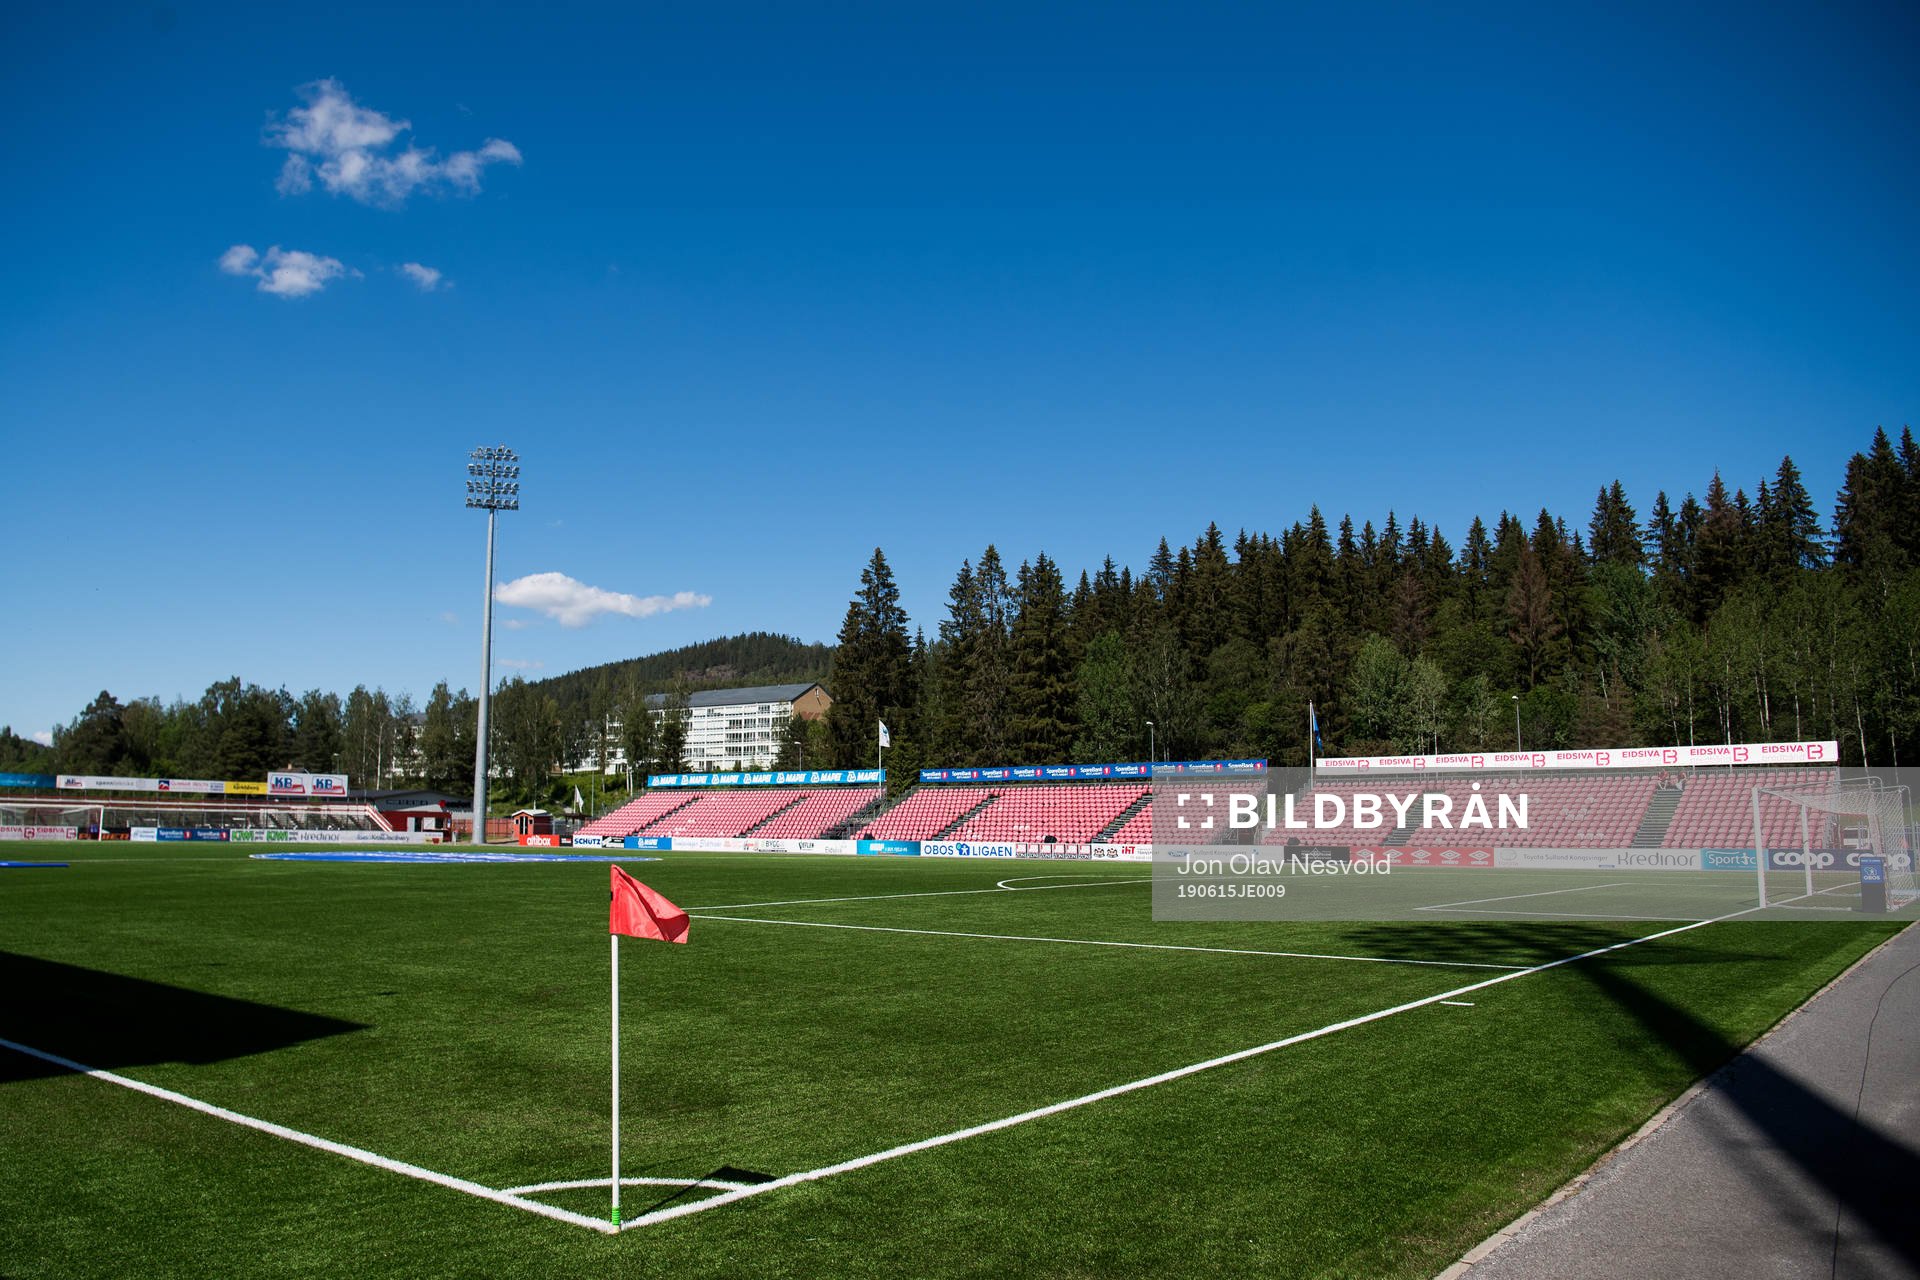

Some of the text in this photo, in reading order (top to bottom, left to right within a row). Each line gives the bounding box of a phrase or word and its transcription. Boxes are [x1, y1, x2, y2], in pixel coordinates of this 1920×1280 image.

[1690, 748, 1730, 756] EIDSIVA
[1761, 745, 1804, 753] EIDSIVA
[1435, 756, 1469, 764] EIDSIVA
[1495, 754, 1530, 762] EIDSIVA
[1557, 752, 1593, 760] EIDSIVA
[1379, 758, 1411, 766] EIDSIVA
[660, 776, 678, 784] MAPEI
[689, 775, 708, 784] MAPEI
[720, 775, 740, 783] MAPEI
[752, 774, 773, 783] MAPEI
[785, 773, 807, 782] MAPEI
[820, 773, 842, 781] MAPEI
[857, 771, 880, 780] MAPEI
[274, 776, 293, 789] KB
[315, 778, 333, 790] KB
[526, 835, 551, 846] altibox
[924, 844, 954, 855] OBOS
[972, 845, 1012, 857] LIGAEN
[1523, 853, 1544, 861] Toyota
[1569, 854, 1608, 862] Kongsvinger
[1617, 851, 1697, 867] Kredinor
[1846, 852, 1911, 870] cp
